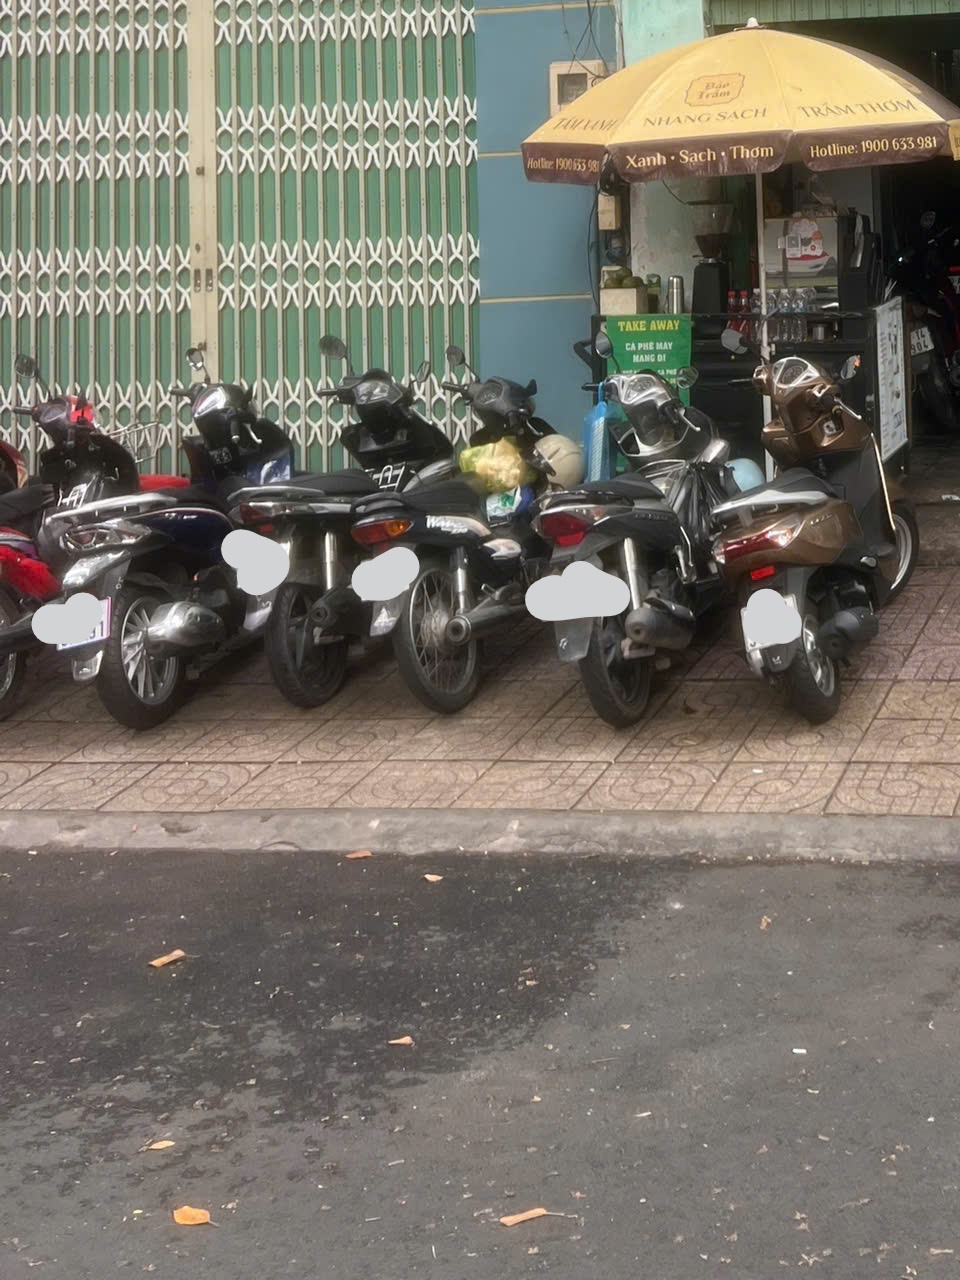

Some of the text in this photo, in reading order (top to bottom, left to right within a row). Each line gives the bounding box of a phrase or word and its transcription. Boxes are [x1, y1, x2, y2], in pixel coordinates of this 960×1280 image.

[643, 113, 711, 128] NHANG
[810, 143, 859, 158] Hotline:
[861, 138, 889, 153] 1900
[892, 137, 915, 151] 633
[917, 135, 938, 149] 981
[626, 152, 667, 169] Xanh
[618, 320, 680, 332] TAKE AWAY
[632, 353, 655, 363] MANG
